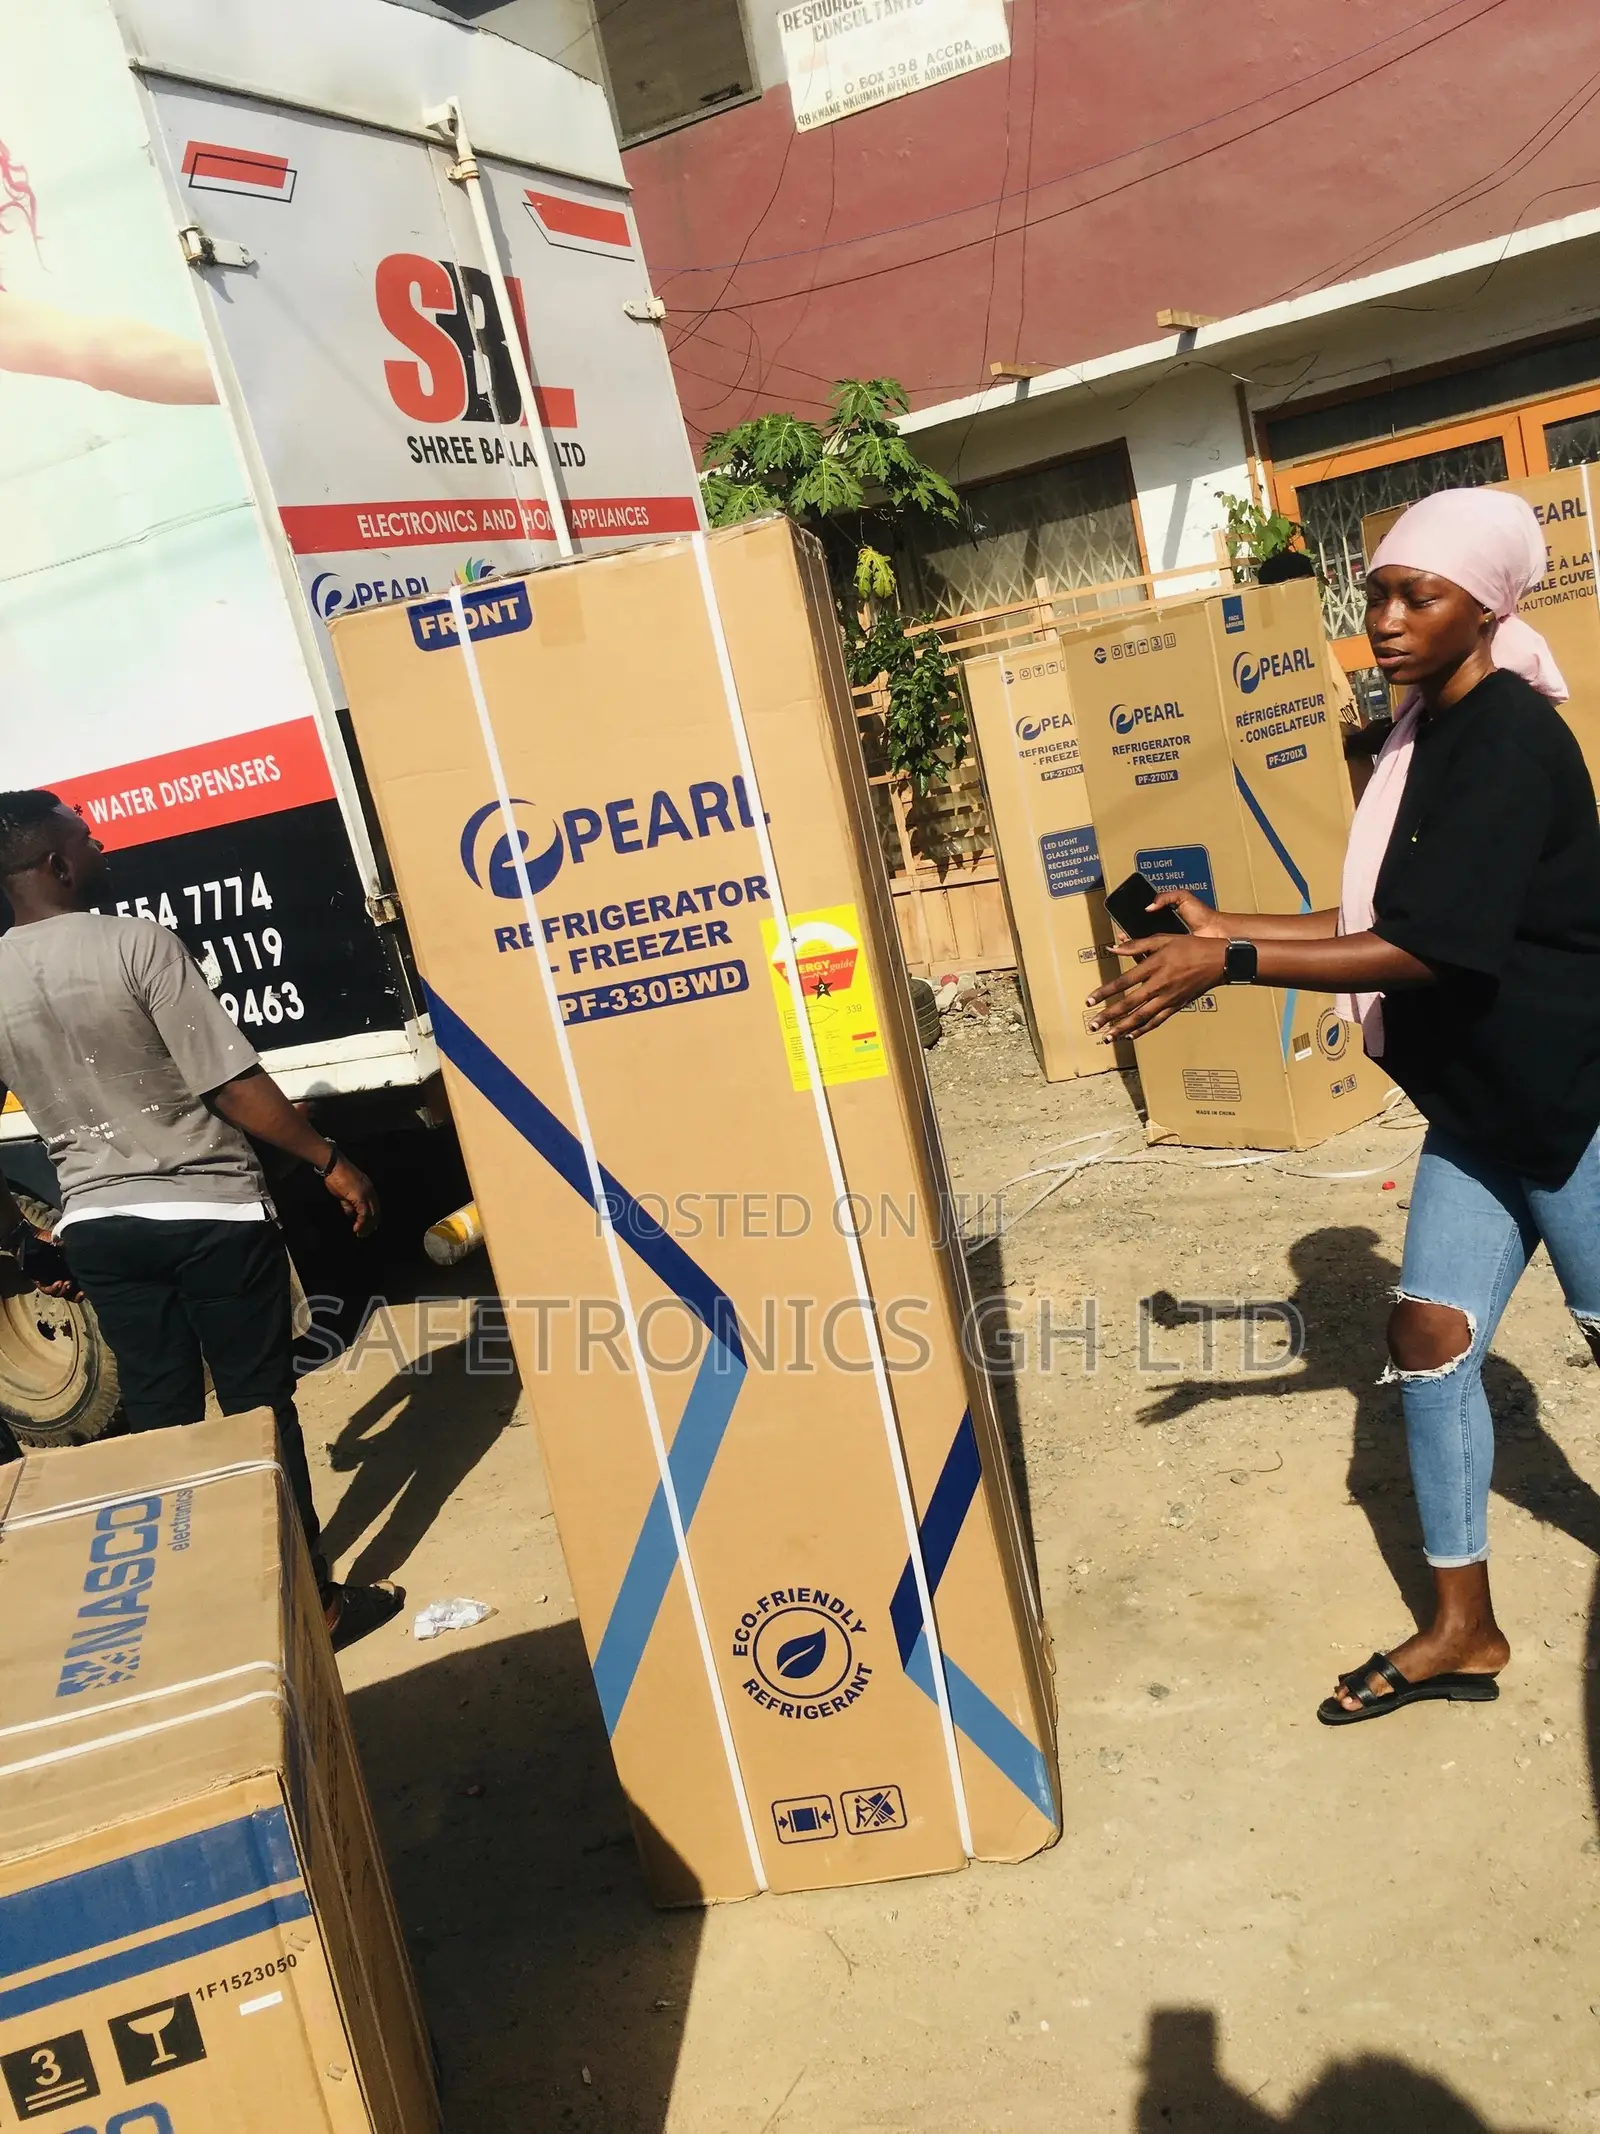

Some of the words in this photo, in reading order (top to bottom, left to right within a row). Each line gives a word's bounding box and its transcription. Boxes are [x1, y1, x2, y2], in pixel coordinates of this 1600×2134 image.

[798, 114, 812, 126] 98
[812, 101, 842, 123] KWAME
[887, 73, 920, 95] AVENUE
[924, 53, 974, 82] ADABRAKA
[974, 42, 1006, 65] ACCRA
[860, 70, 885, 90] BOX
[888, 58, 918, 79] 398
[375, 253, 578, 428] SBL
[406, 435, 478, 465] SHREE
[553, 441, 586, 467] LTD
[357, 508, 478, 539] ELECTRONICS
[482, 508, 517, 531] AND
[571, 506, 650, 530] APPLIANCES
[1533, 497, 1587, 526] EARL
[1532, 578, 1557, 593] BLE
[1560, 568, 1595, 587] CUVE
[419, 597, 520, 640] FRONT
[1259, 647, 1315, 680] PEARL
[1041, 713, 1073, 732] PEA
[1134, 701, 1184, 725] PEARL
[1235, 693, 1325, 728] RÉFRIGÉRATEUR
[1246, 711, 1326, 743] CONGELATEUR
[1019, 737, 1079, 760] REFRIGERA
[1039, 749, 1080, 765] FREEZE
[1112, 734, 1191, 756] REFRIGERATOR
[1132, 750, 1180, 766] FREEZER
[1269, 749, 1305, 767] PF-270IX
[1044, 766, 1082, 780] PF-270IX
[1138, 772, 1175, 784] PF-270IX
[88, 787, 158, 824] WATER
[159, 754, 282, 807] DISPENSERS
[563, 774, 771, 864] PEARL
[1043, 842, 1057, 851] LED
[1058, 838, 1078, 848] LIGHT
[1046, 851, 1069, 861] GLASS
[1069, 844, 1090, 855] SHELF
[1048, 857, 1082, 870] RECESSED
[1050, 868, 1079, 881] OUTSIDE
[1140, 861, 1152, 870] LED
[1153, 858, 1173, 868] LIGHT
[1165, 871, 1185, 880] SHELF
[1052, 875, 1096, 890] CONDENSER
[1179, 882, 1208, 892] HANDLE
[183, 871, 273, 925] 7774
[494, 875, 771, 953] REFRIGERATOR
[568, 920, 733, 974] FREEZER
[830, 958, 855, 973] guide
[561, 966, 742, 1021] PF-330BWD
[819, 984, 826, 992] 2
[220, 981, 305, 1027] 9463
[167, 1488, 194, 1552] electronics
[64, 1494, 163, 1659] NASCO
[732, 1587, 868, 1657] ECO-FRIENDLY
[742, 1662, 873, 1720] REFRIGERANT
[196, 1953, 298, 2002] 1F1523050
